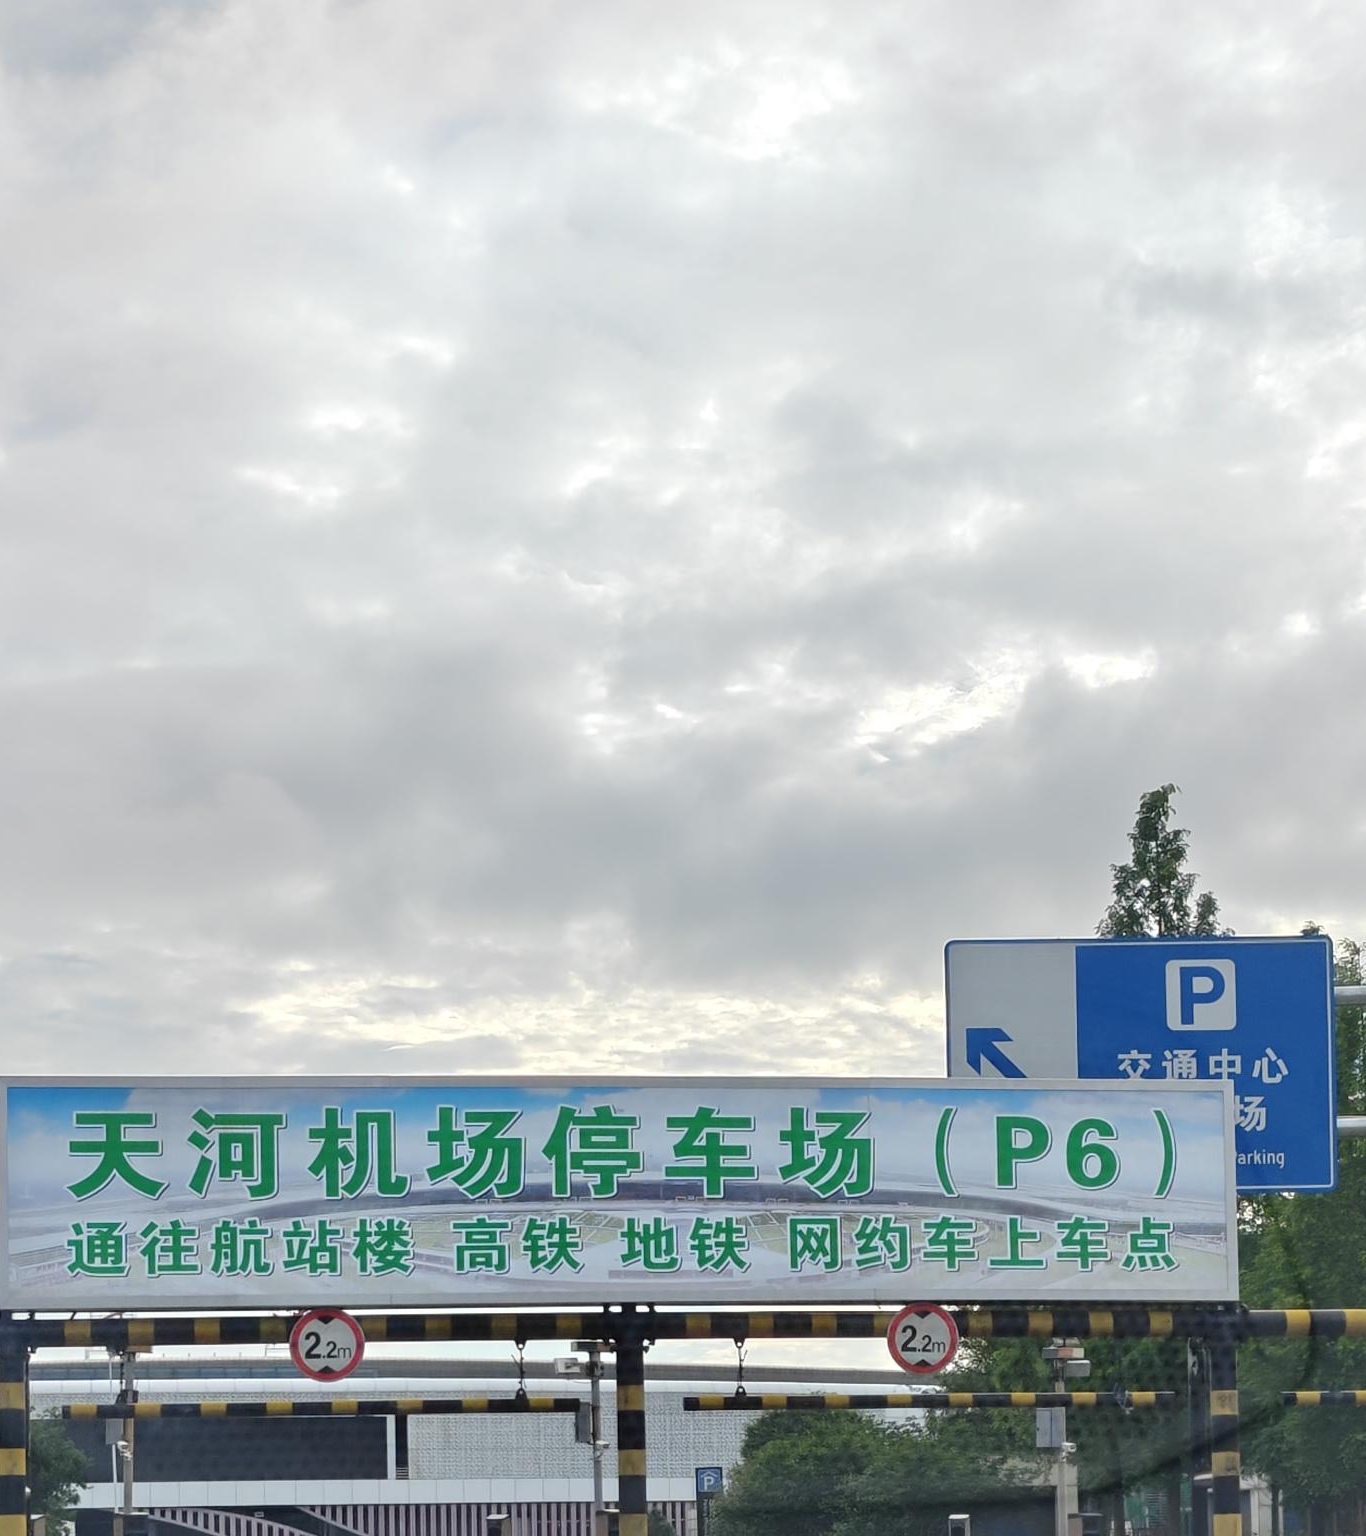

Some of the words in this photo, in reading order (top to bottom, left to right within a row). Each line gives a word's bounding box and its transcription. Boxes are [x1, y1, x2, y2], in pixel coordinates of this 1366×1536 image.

[1180, 966, 1225, 1026] P
[1116, 1047, 1290, 1084] 交通中心
[1235, 1148, 1285, 1169] arking
[65, 1219, 415, 1278] 通往航站楼
[451, 1217, 583, 1275] 高铁
[620, 1217, 751, 1274] 地铁
[788, 1215, 1180, 1274] 网约车上车点
[304, 1331, 352, 1360] 2.2m
[900, 1324, 946, 1353] 2.2m
